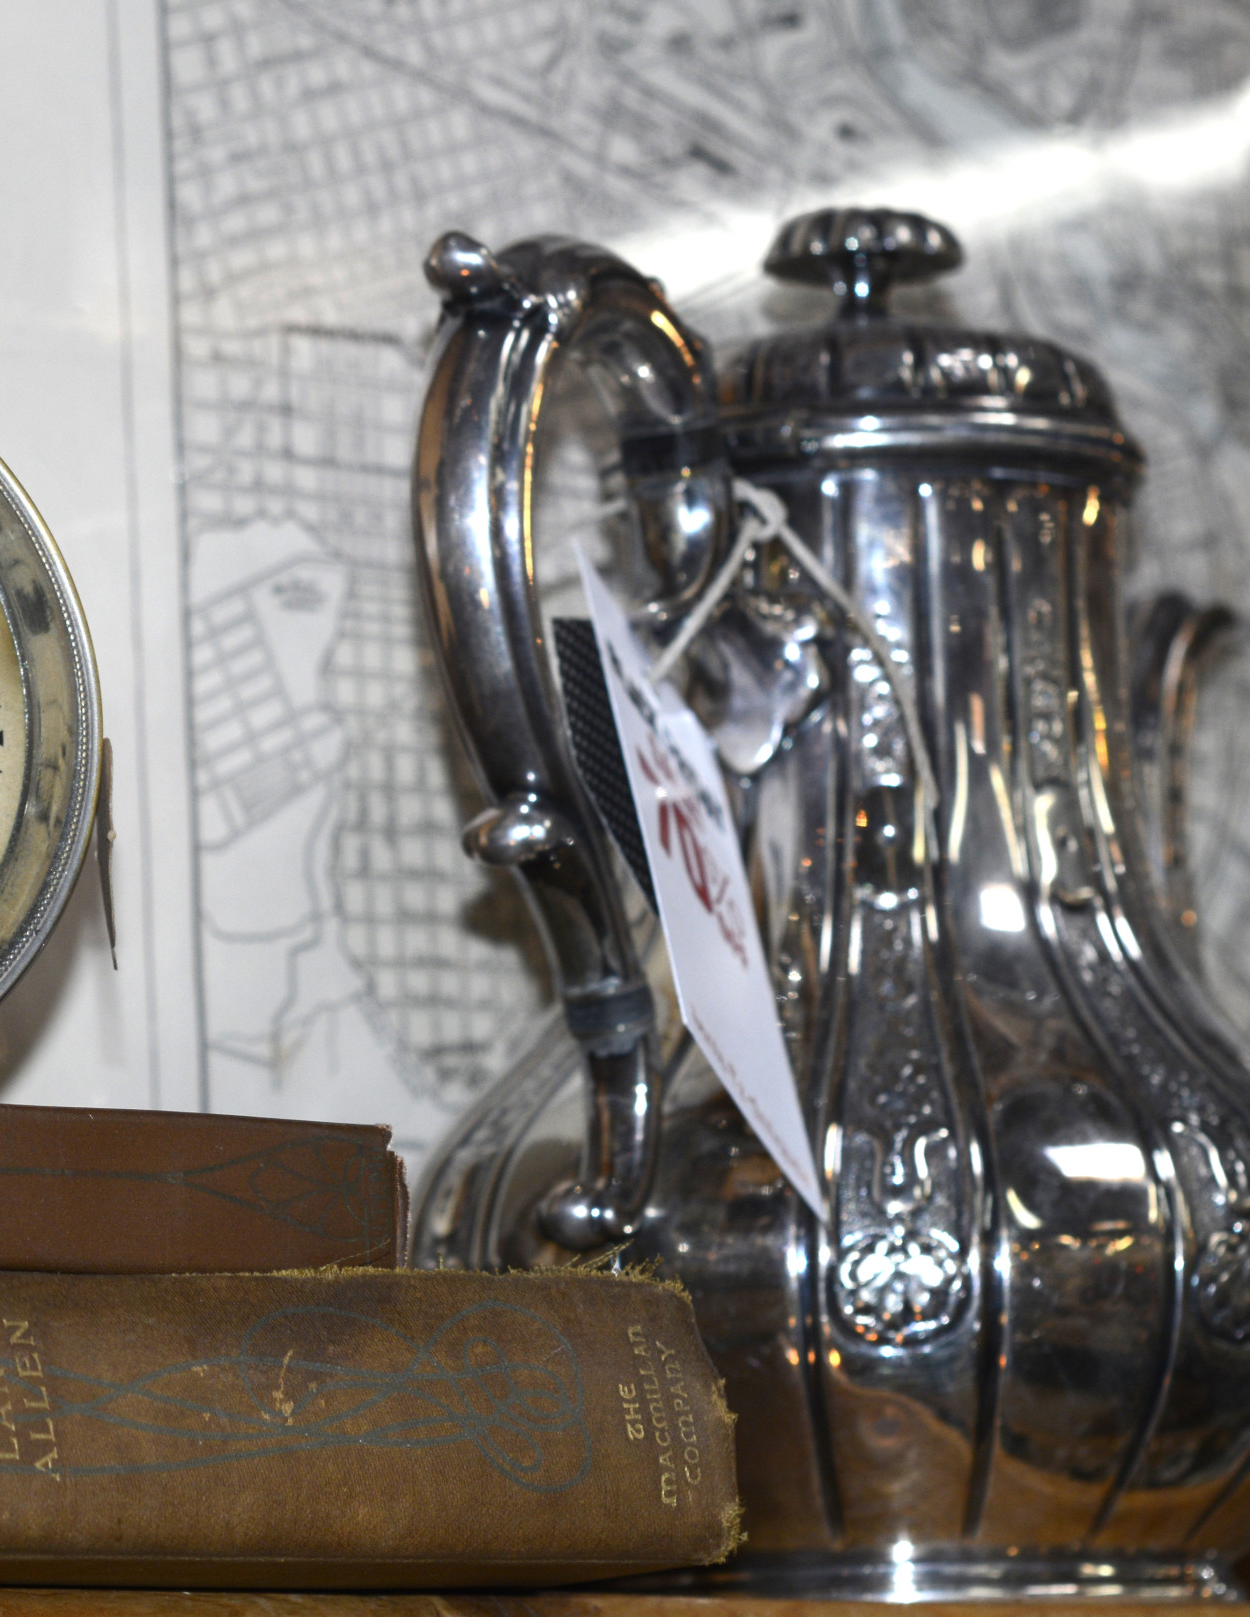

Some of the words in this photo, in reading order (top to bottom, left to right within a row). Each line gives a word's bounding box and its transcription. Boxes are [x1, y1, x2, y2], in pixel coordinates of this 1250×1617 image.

[2, 1317, 61, 1482] ALLEN
[618, 1382, 646, 1441] THE
[655, 1340, 701, 1486] COMPANY
